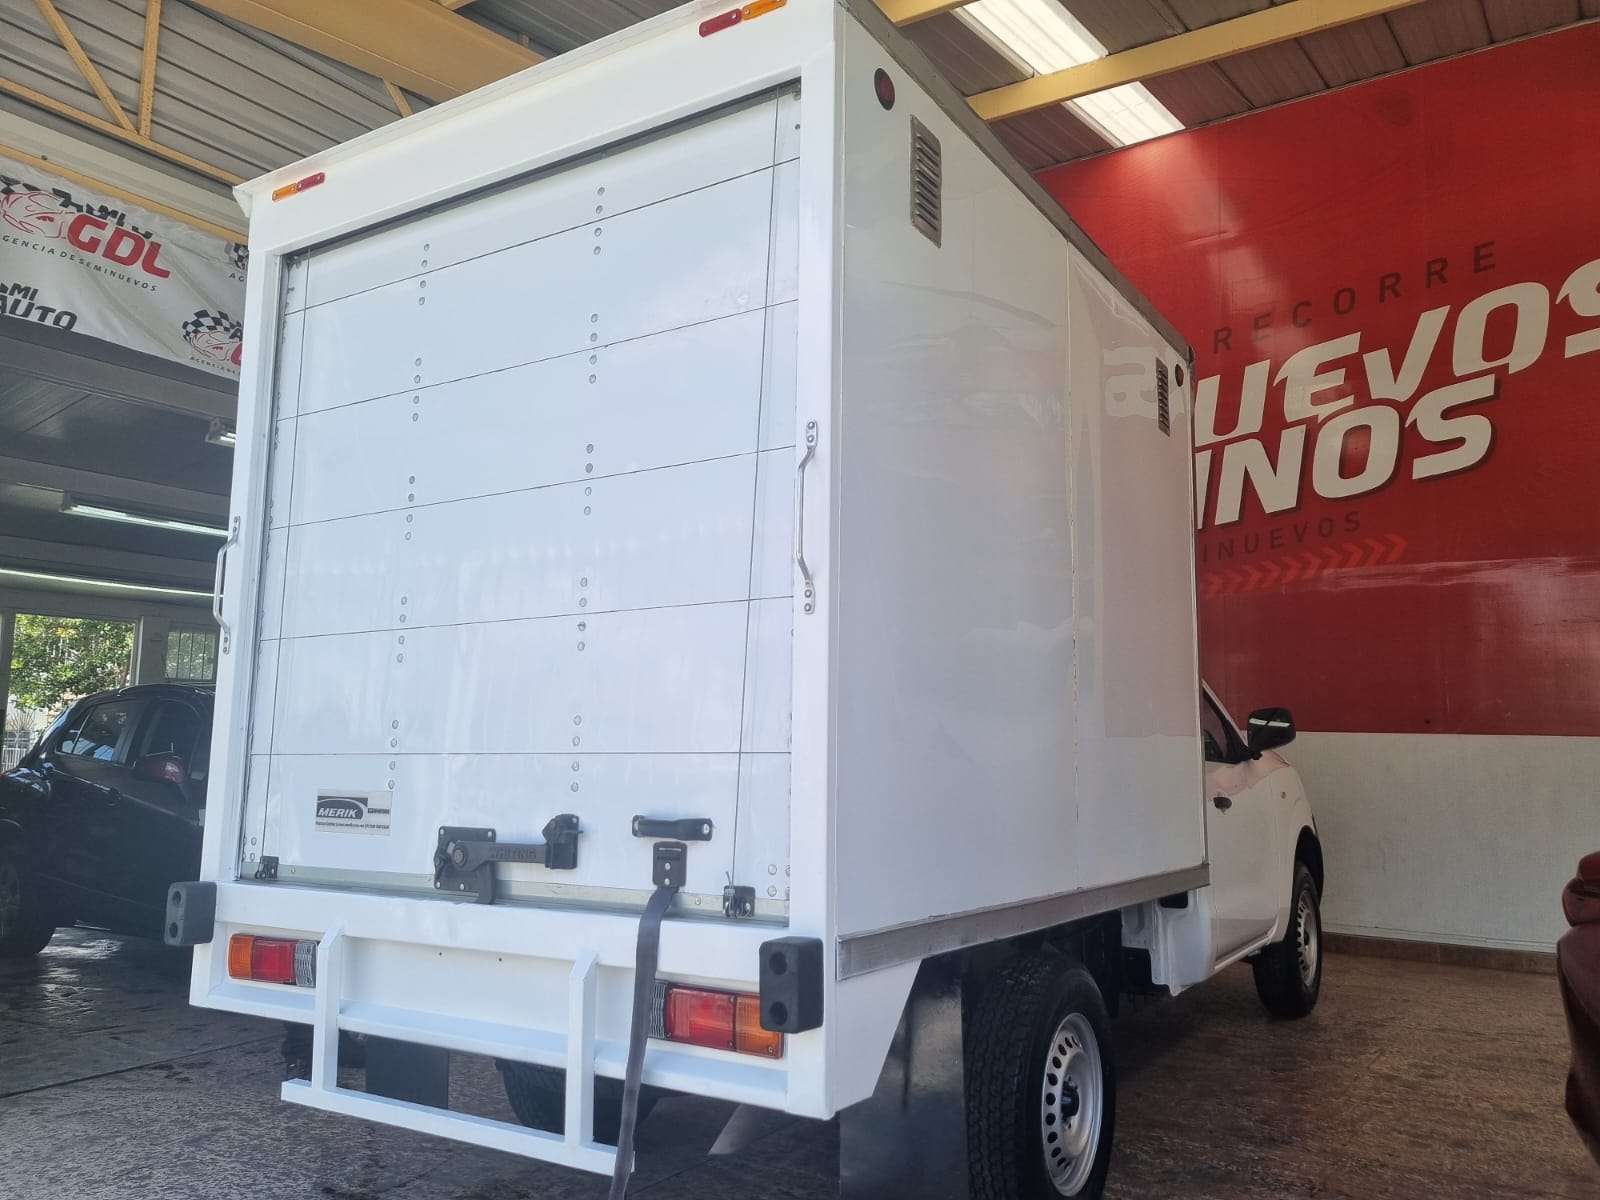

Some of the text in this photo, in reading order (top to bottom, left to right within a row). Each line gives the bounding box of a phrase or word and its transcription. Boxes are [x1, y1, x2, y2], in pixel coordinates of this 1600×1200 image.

[67, 213, 171, 279] GDL
[8, 282, 40, 301] MI
[1212, 239, 1498, 354] RECORRE
[318, 807, 359, 819] MERIK
